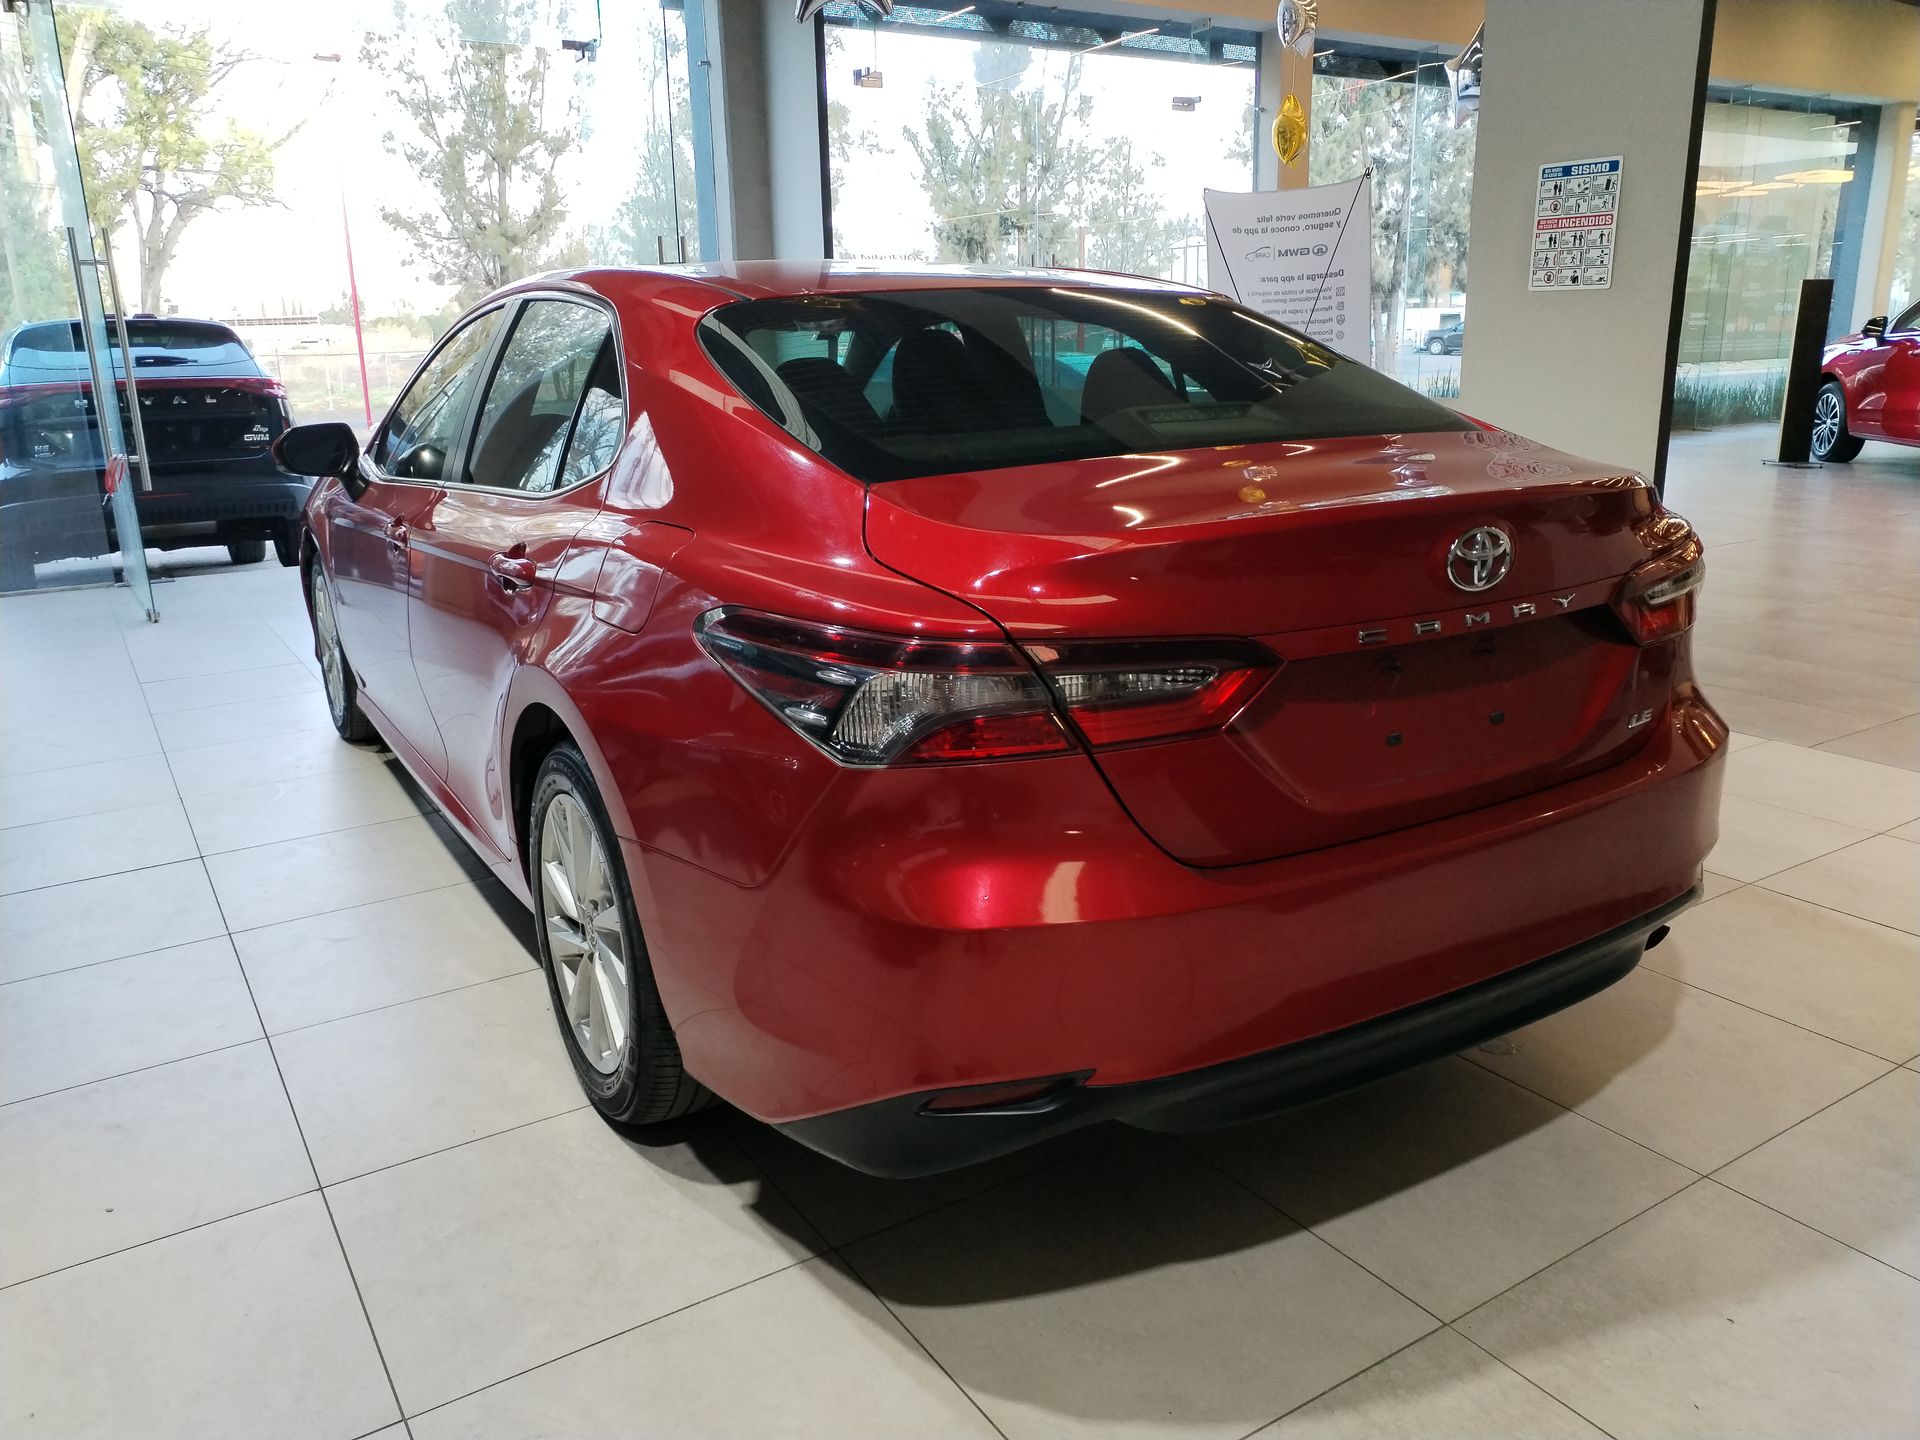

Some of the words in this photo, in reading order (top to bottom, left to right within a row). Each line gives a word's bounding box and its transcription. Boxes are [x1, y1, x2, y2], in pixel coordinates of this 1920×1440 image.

[1571, 163, 1610, 175] SISMO
[1558, 215, 1612, 228] INCENDIOS
[244, 433, 269, 441] GWM
[1358, 594, 1576, 643] CAMRY
[1628, 709, 1652, 728] LE
